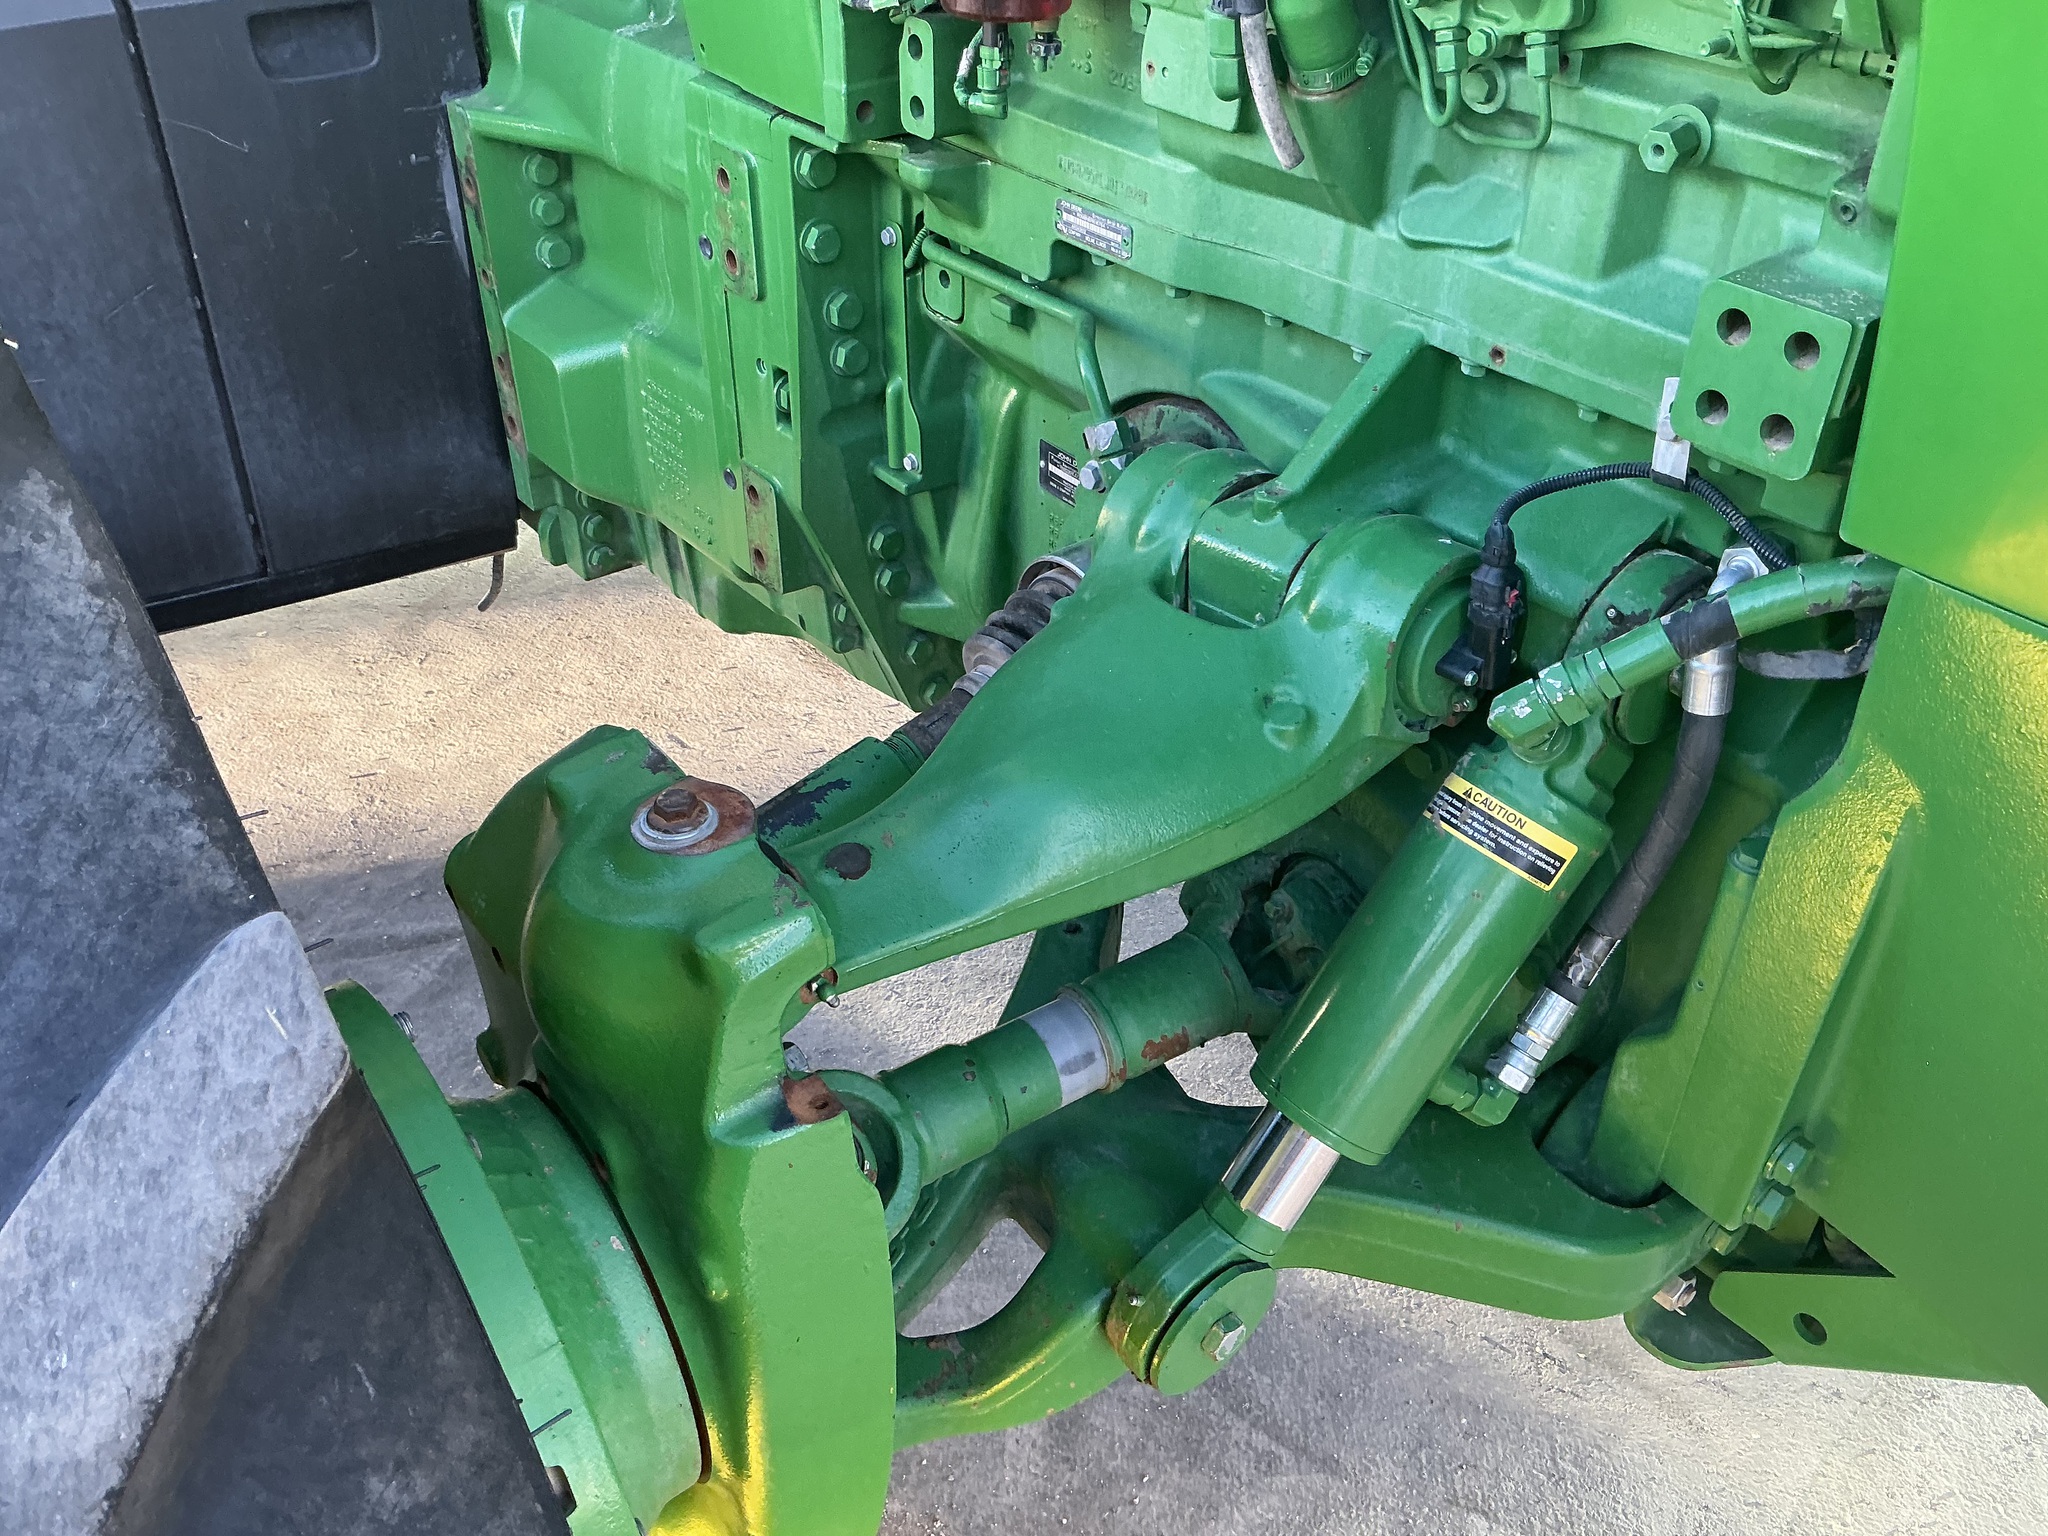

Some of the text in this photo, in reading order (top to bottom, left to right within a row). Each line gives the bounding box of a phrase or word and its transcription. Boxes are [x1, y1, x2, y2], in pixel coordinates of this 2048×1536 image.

[1472, 792, 1527, 830] CAUTION
[1471, 821, 1489, 834] dealer
[1488, 830, 1498, 839] for
[1497, 835, 1528, 858] instruction
[1527, 854, 1536, 863] on
[1473, 831, 1497, 849] system.
[1484, 819, 1516, 842] movement
[1515, 838, 1530, 849] and
[1528, 846, 1555, 865] exposure
